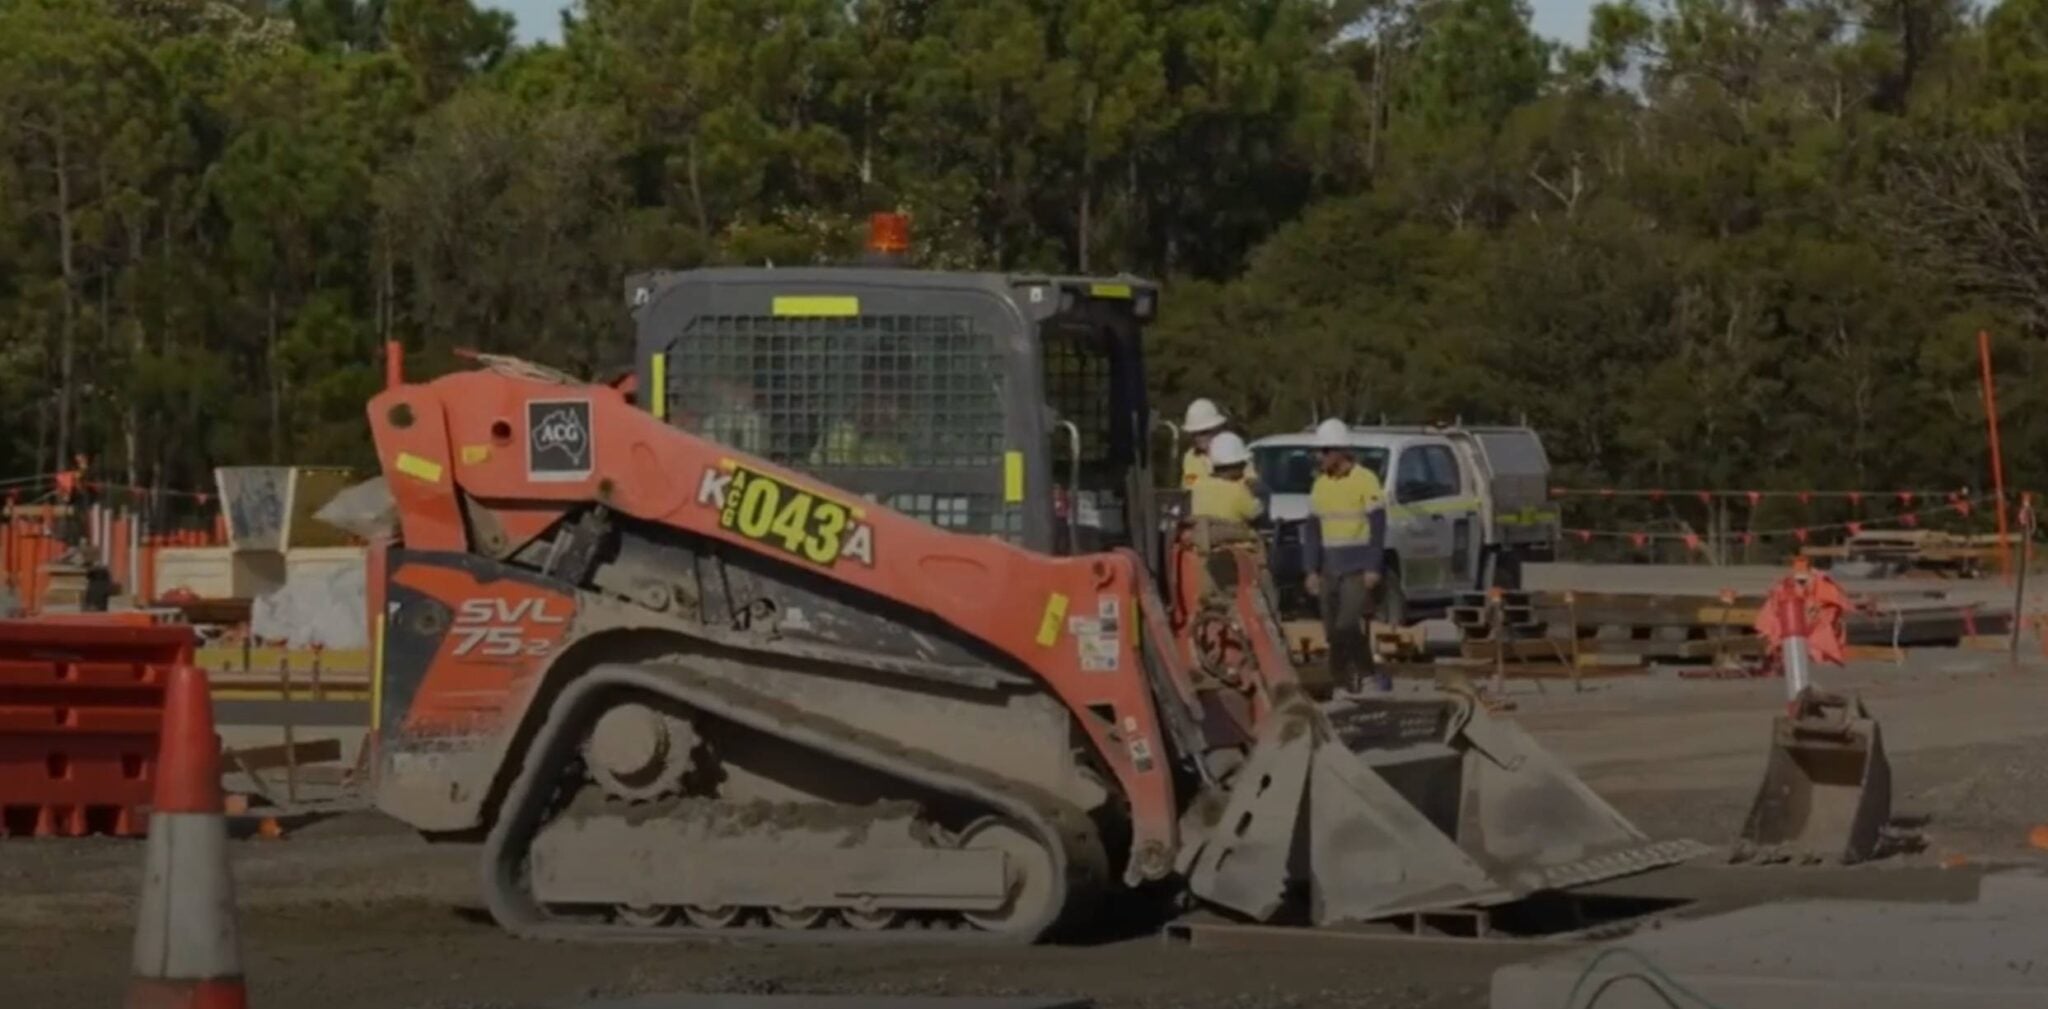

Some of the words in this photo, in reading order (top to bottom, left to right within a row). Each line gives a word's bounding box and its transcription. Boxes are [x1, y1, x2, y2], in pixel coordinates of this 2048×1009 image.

[541, 424, 579, 442] ACG
[737, 477, 846, 564] 043
[456, 598, 563, 624] SVL
